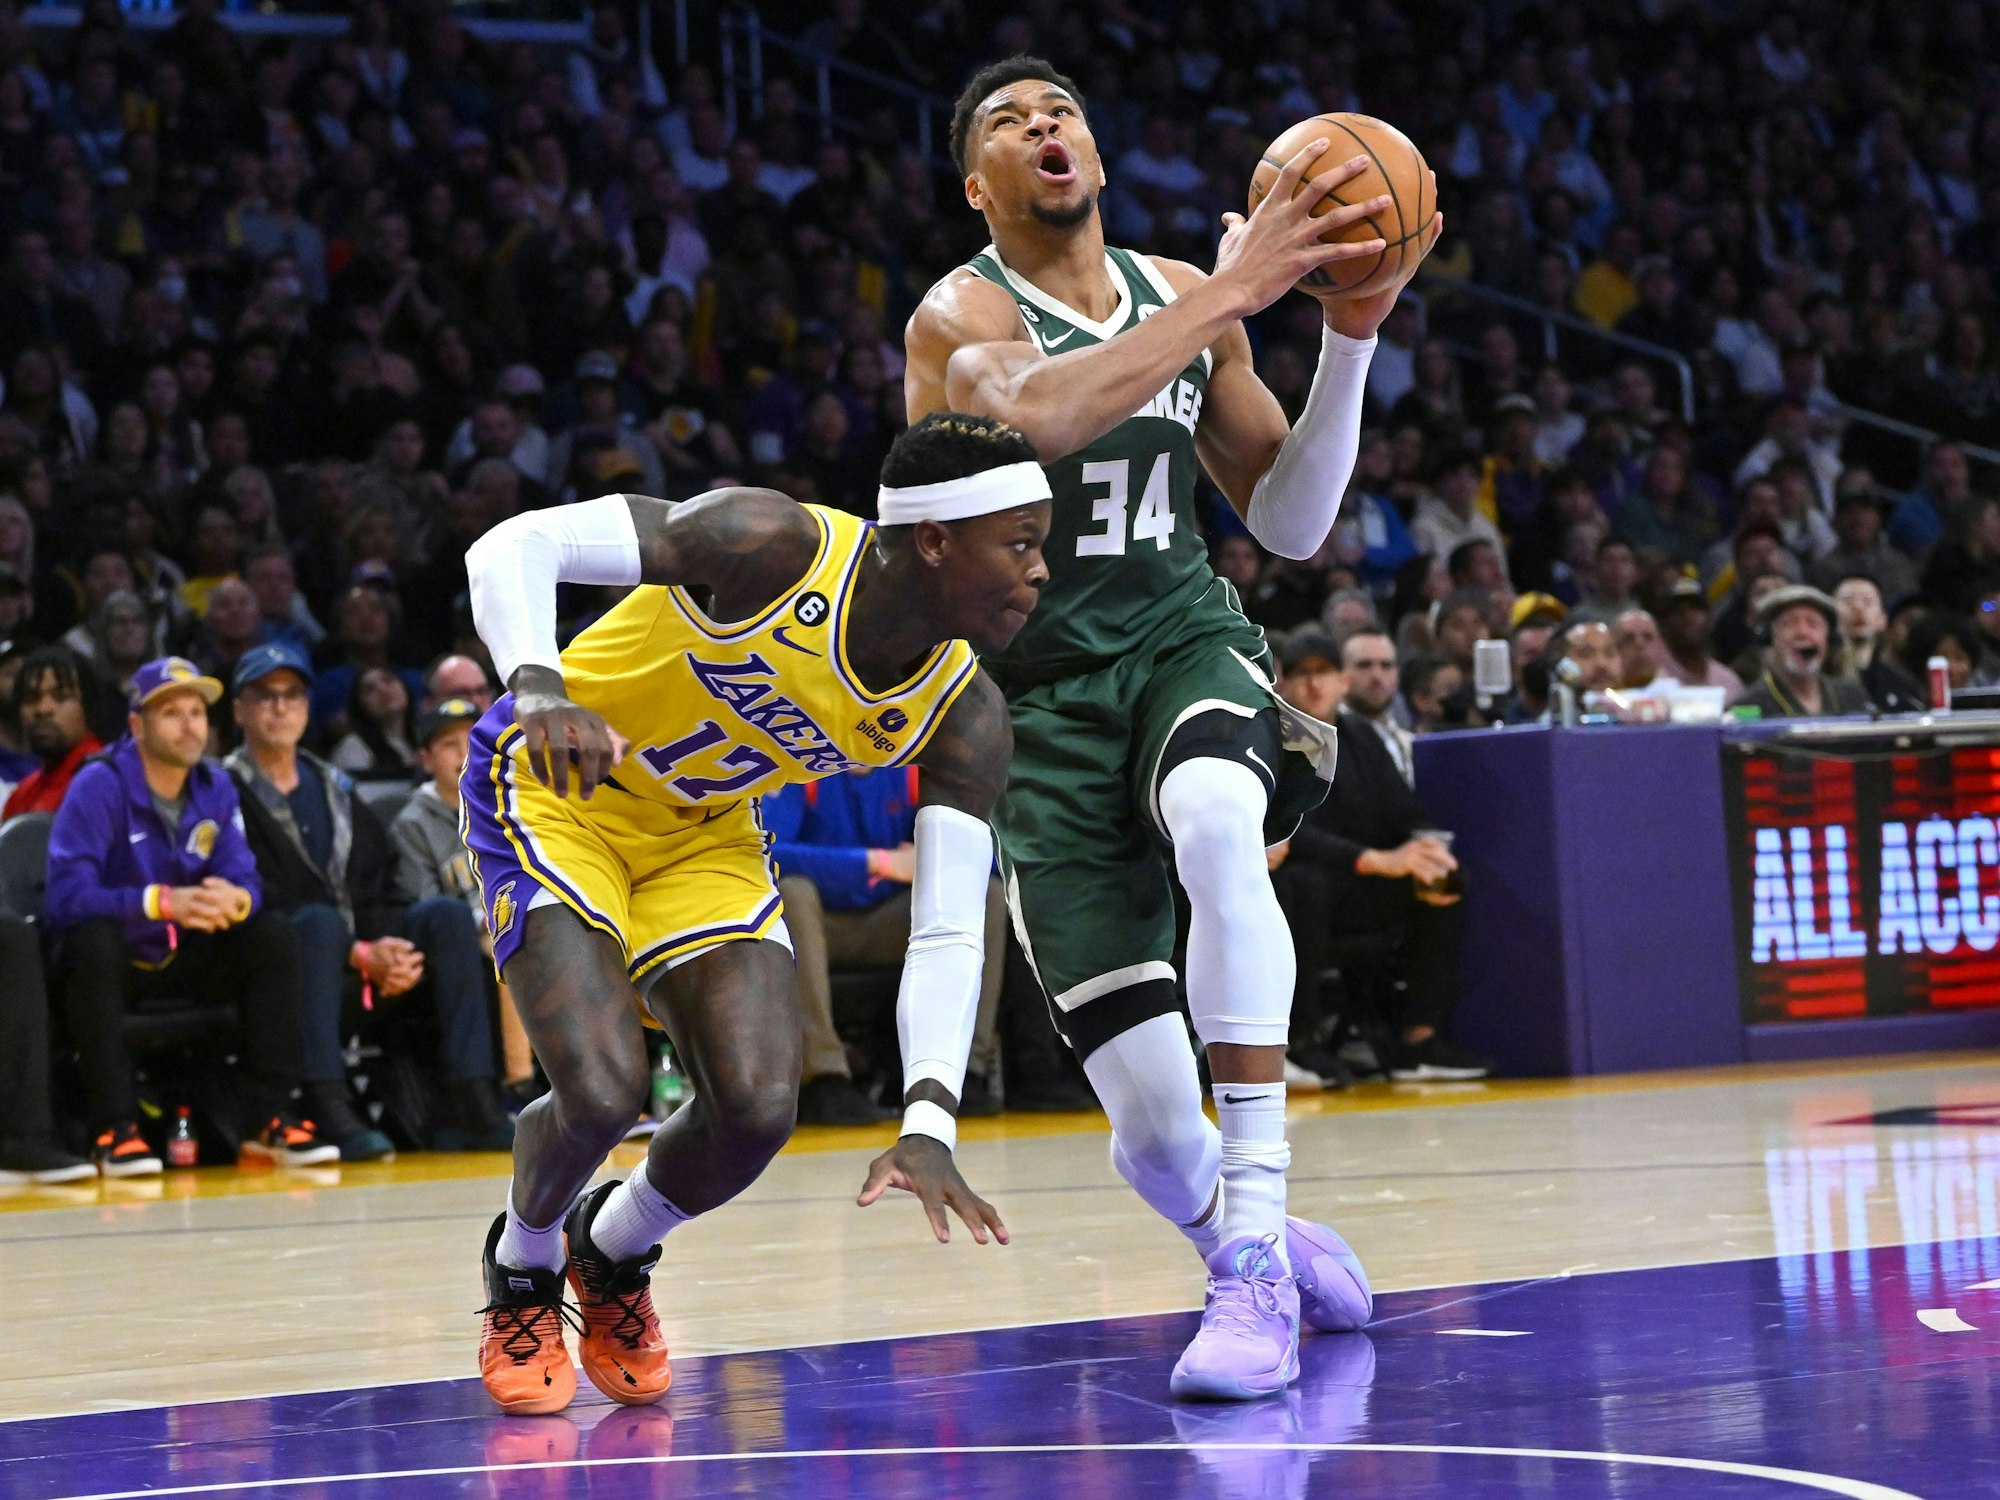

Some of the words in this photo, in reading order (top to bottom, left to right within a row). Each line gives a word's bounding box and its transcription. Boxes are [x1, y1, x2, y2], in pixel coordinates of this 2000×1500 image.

[1018, 303, 1040, 323] 6
[1075, 452, 1176, 558] 34
[798, 595, 826, 623] 6
[855, 719, 896, 752] bibigo
[1751, 824, 1867, 963] ALL
[1878, 816, 2000, 954] ACC
